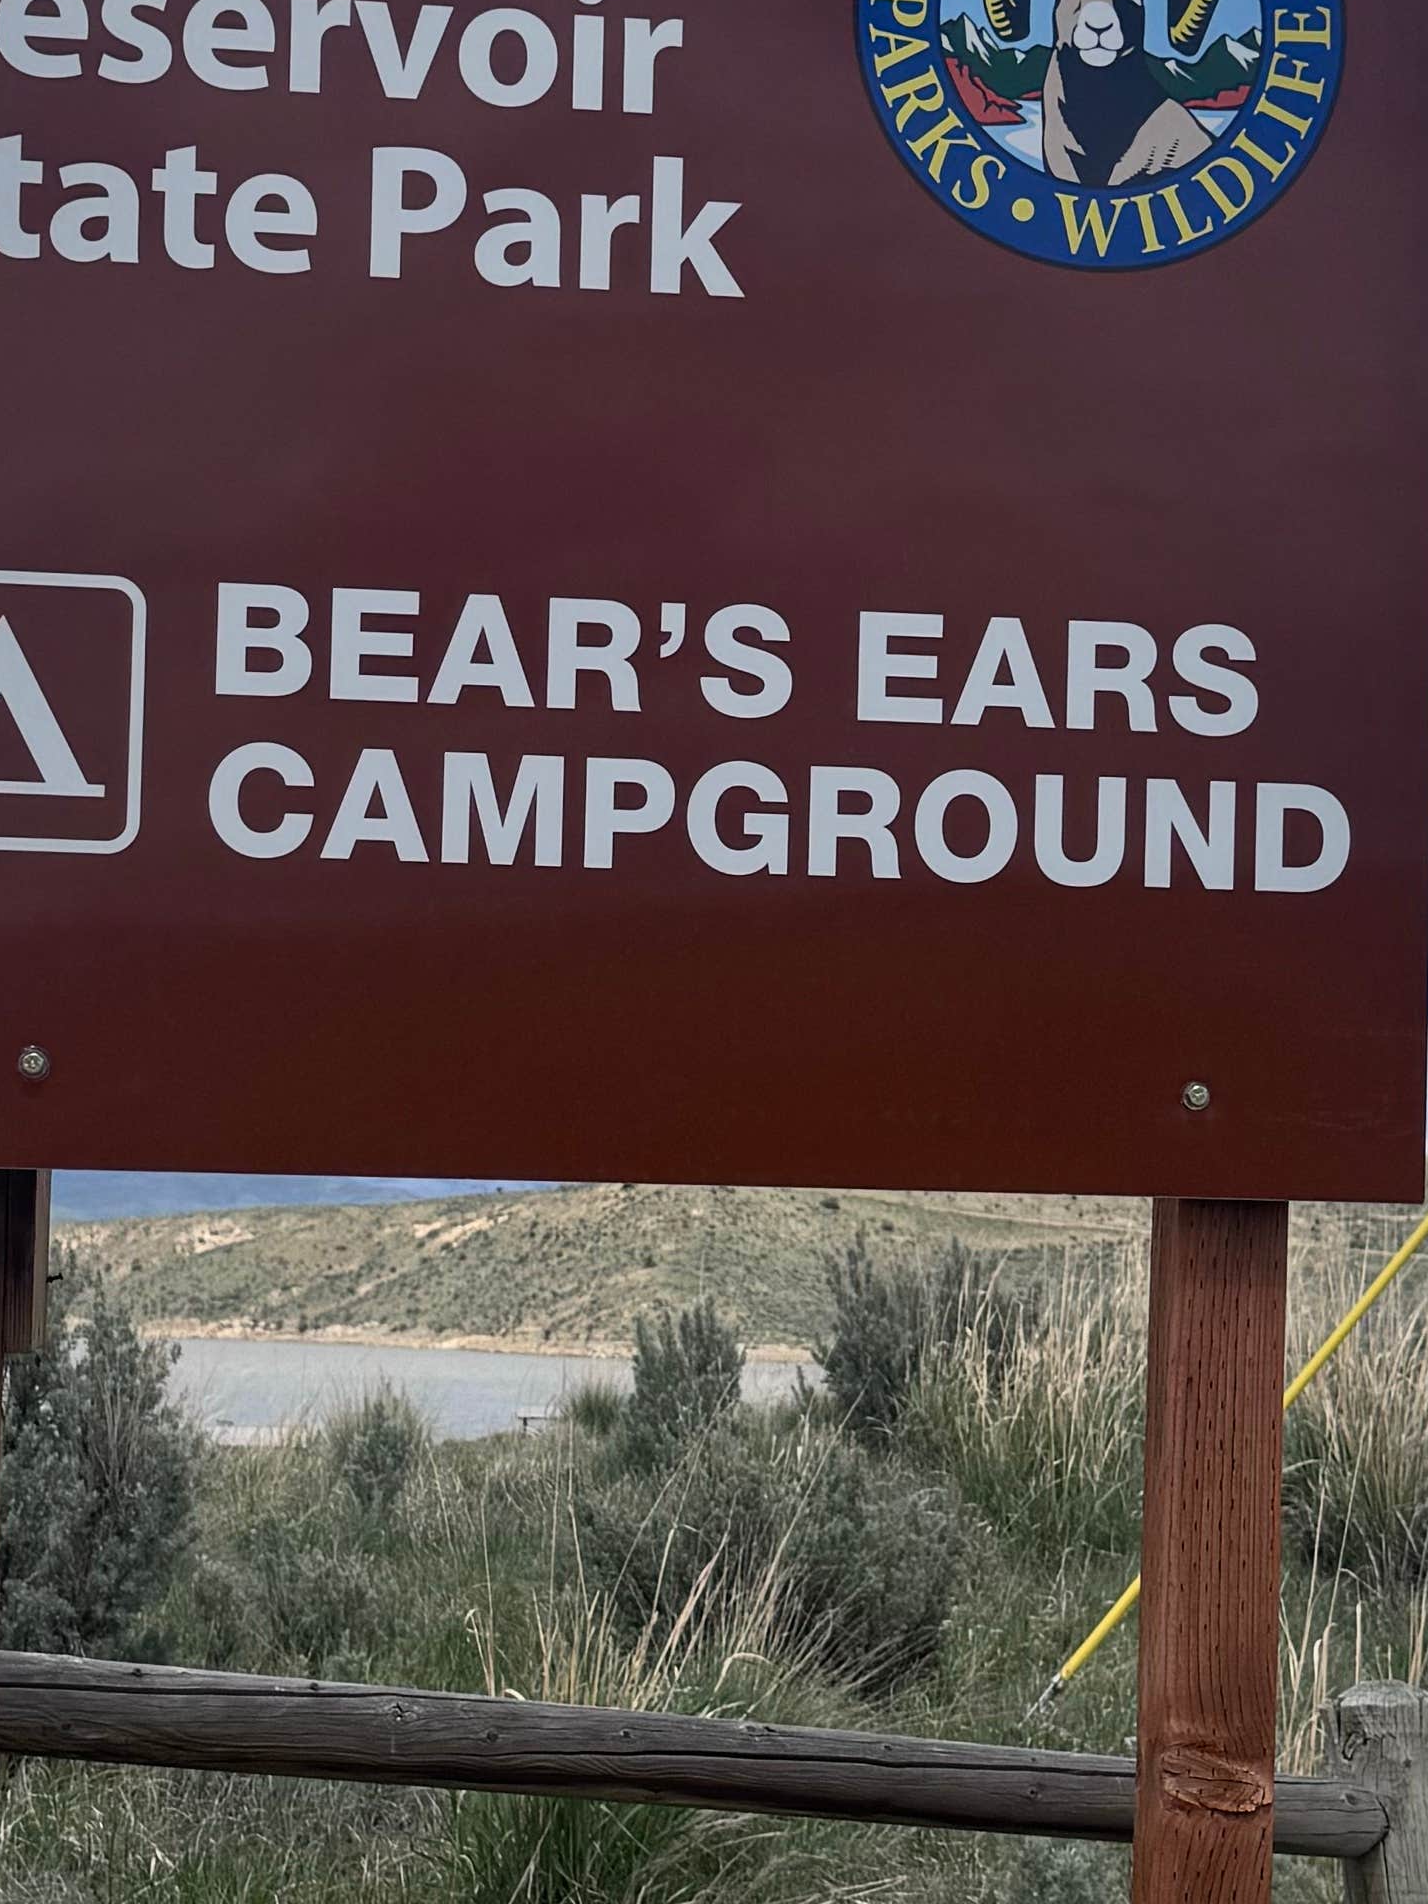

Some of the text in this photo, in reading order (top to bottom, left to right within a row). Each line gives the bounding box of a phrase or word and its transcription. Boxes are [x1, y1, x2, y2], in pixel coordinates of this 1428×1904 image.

[1055, 5, 1332, 257] WILDLIFE
[368, 145, 746, 299] Park
[856, 609, 1260, 738] EARS
[207, 740, 1352, 894] CAMPGROUND
